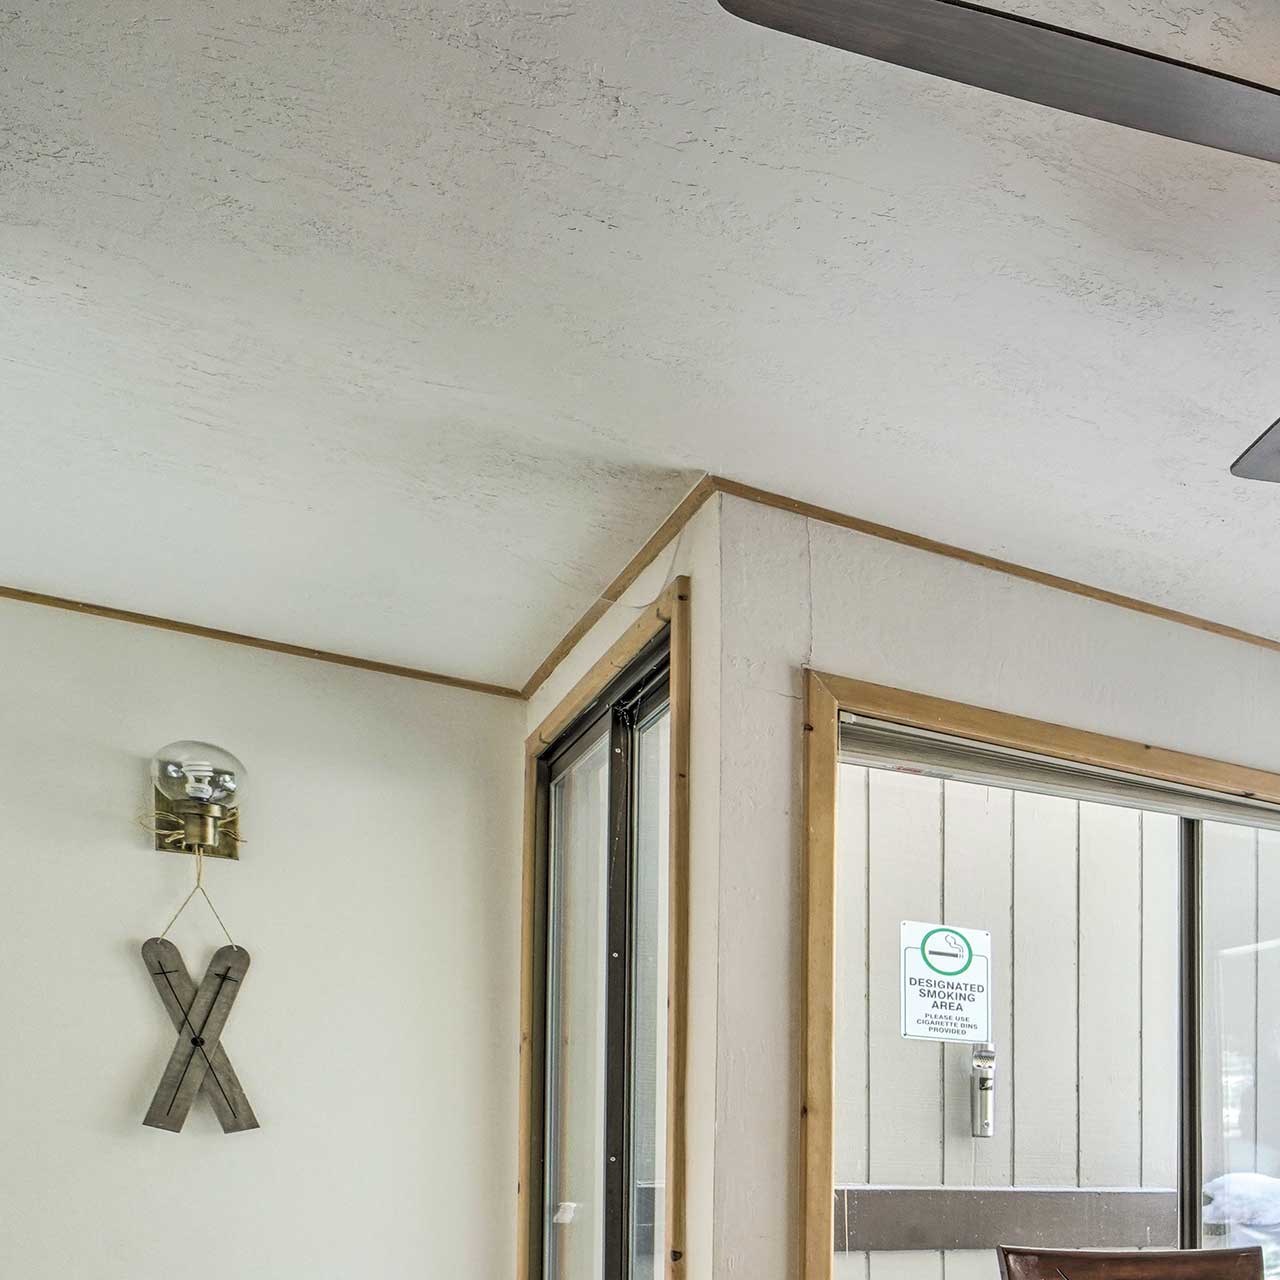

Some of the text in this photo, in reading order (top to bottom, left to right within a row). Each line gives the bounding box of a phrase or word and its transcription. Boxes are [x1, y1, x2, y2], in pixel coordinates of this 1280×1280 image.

[909, 977, 984, 993] DESIGNATED
[919, 988, 975, 1002] SMOKING
[931, 1000, 963, 1011] AREA
[916, 1018, 958, 1027] CIGARETTE
[928, 1026, 966, 1035] PROVIDED
